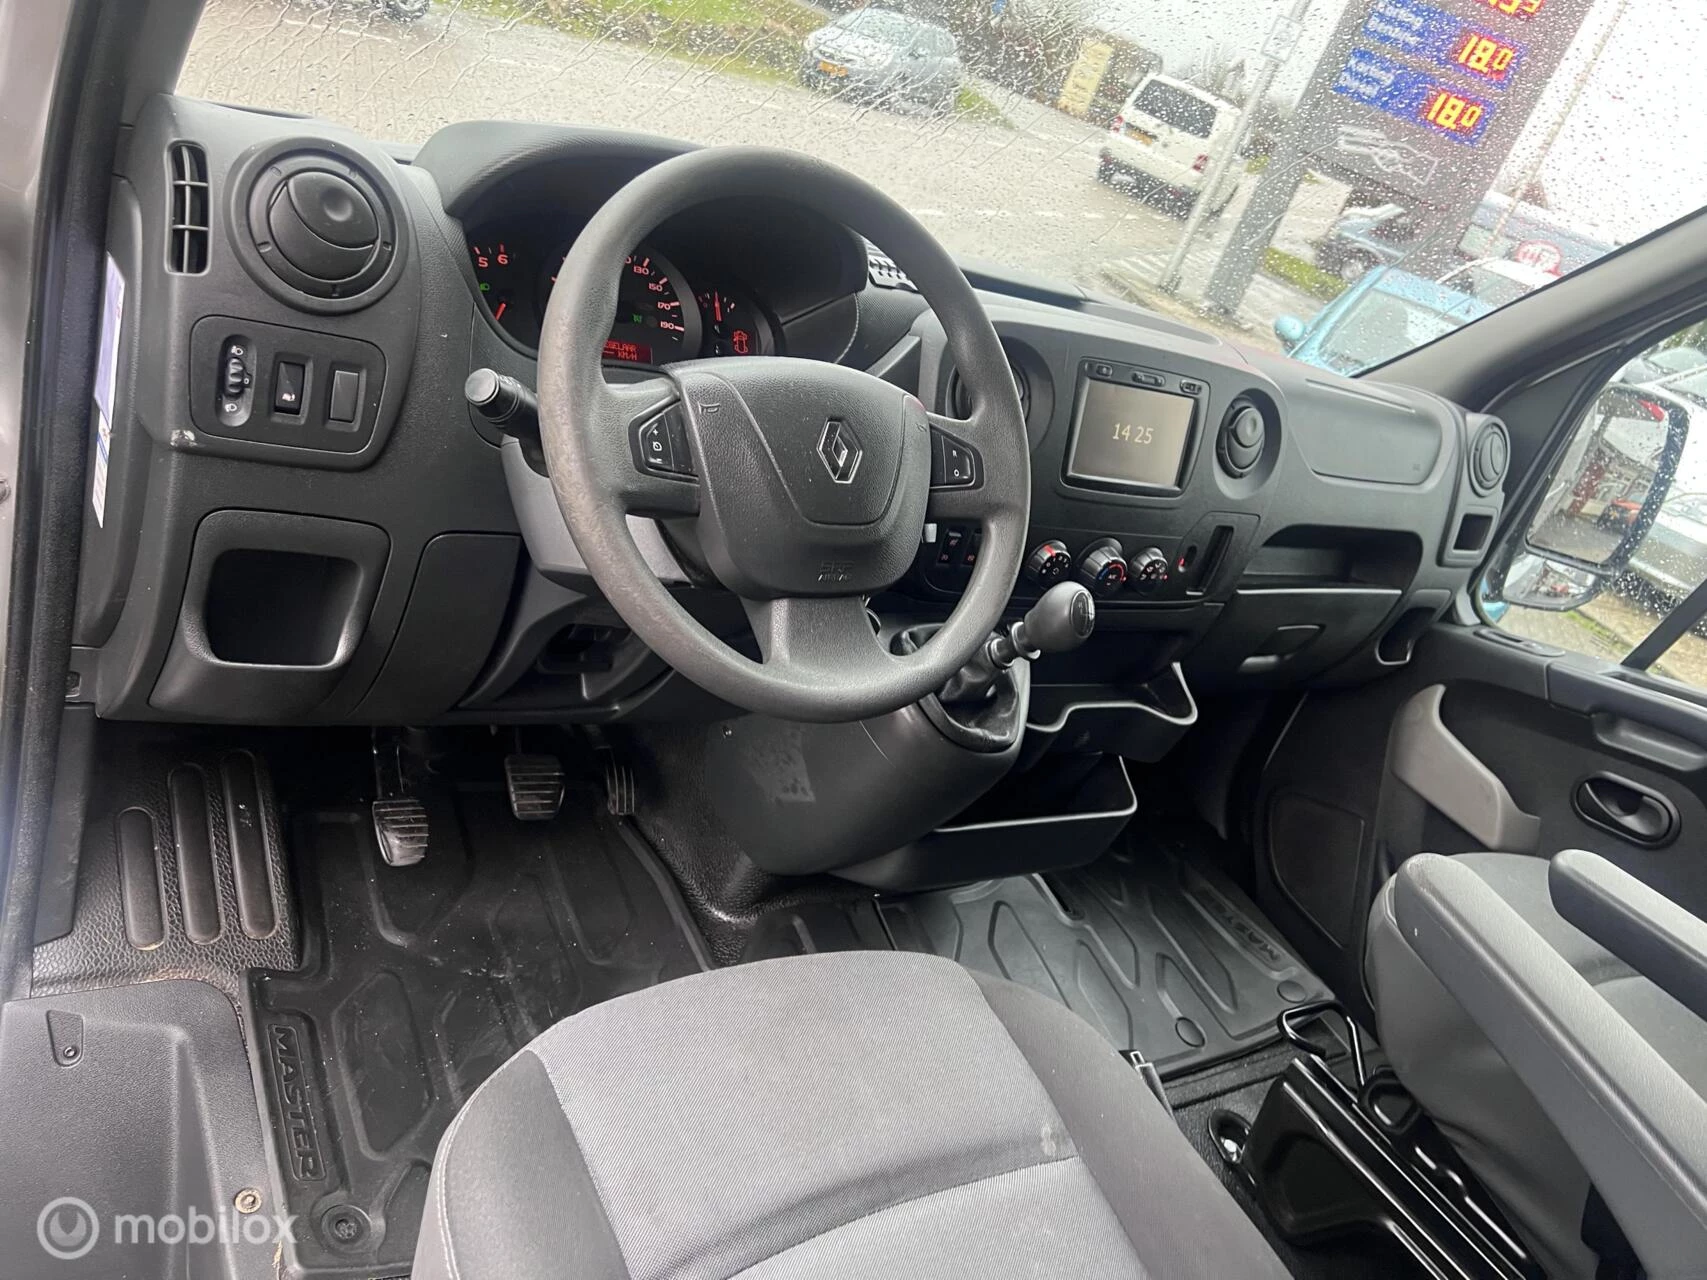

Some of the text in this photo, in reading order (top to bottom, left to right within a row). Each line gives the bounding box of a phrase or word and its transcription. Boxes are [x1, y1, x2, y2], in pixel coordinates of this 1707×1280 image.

[478, 257, 489, 268] 5
[497, 254, 509, 265] 6
[633, 266, 649, 275] 130
[648, 282, 663, 292] 150
[657, 301, 671, 311] 170
[660, 321, 675, 330] 190
[1134, 426, 1154, 445] 25
[272, 1025, 321, 1180] MASTER
